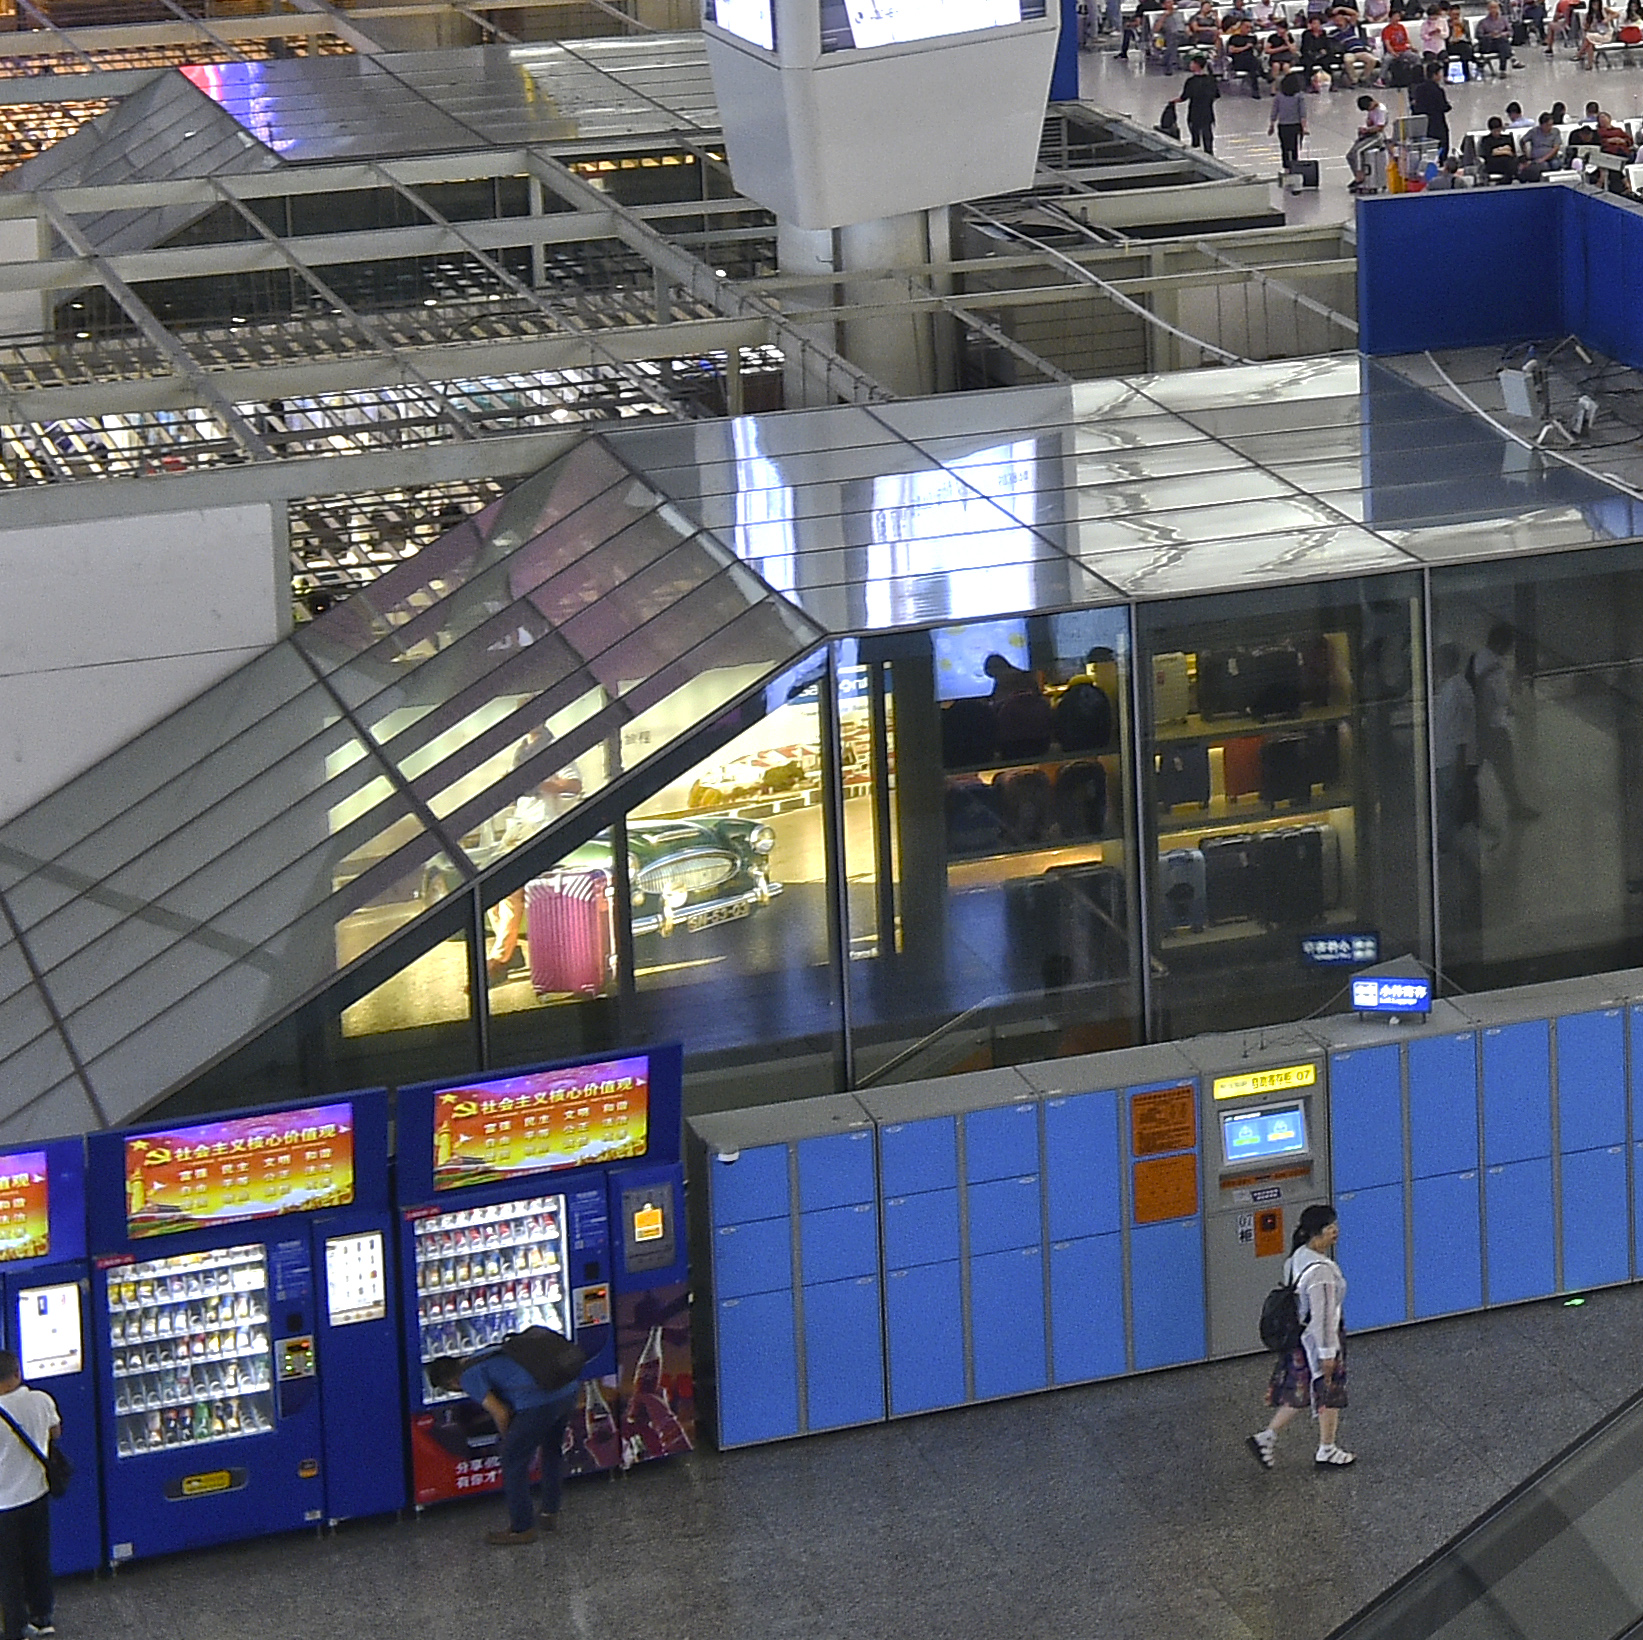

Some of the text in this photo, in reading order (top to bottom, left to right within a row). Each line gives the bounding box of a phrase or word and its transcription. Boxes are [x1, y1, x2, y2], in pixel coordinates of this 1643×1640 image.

[1296, 1070, 1310, 1081] 07
[480, 1077, 633, 1115] 社会主义核心价值观
[564, 1107, 590, 1120] 文明
[174, 1124, 337, 1162] 社会主义核心价值观
[263, 1154, 291, 1167] 文明
